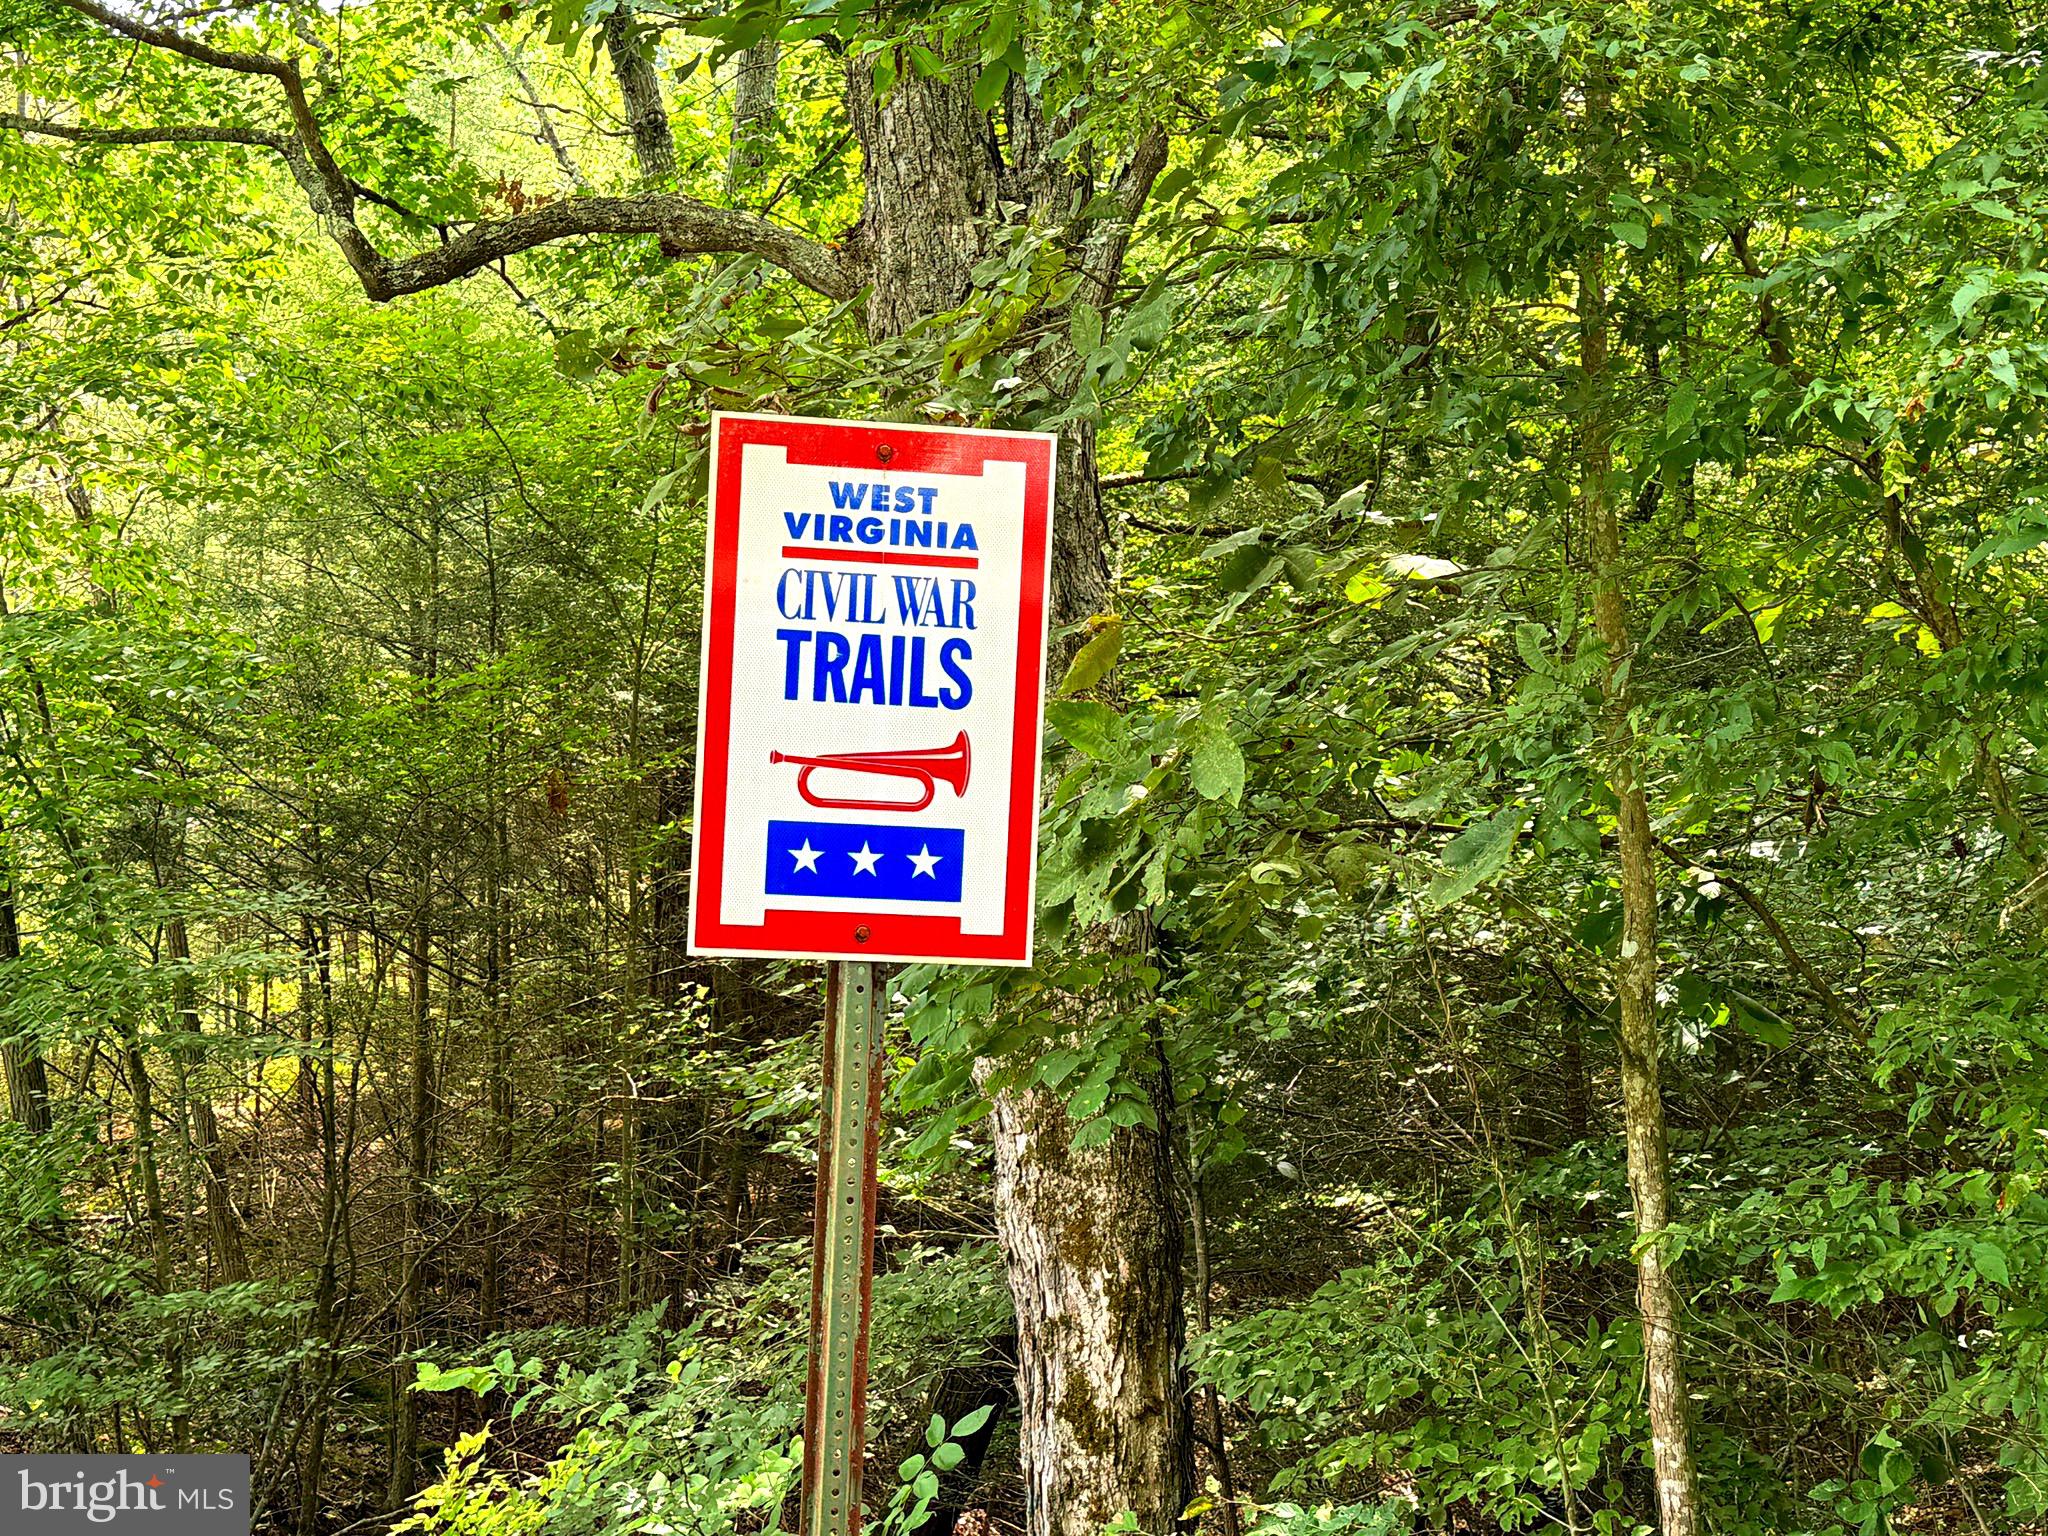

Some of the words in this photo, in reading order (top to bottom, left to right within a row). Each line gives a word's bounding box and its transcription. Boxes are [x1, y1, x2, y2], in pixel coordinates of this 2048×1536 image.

[828, 481, 938, 514] WEST
[783, 511, 979, 551] VIRGINIA
[776, 567, 886, 625] CIVIL
[891, 575, 978, 630] WAR
[776, 628, 973, 710] TRAILS
